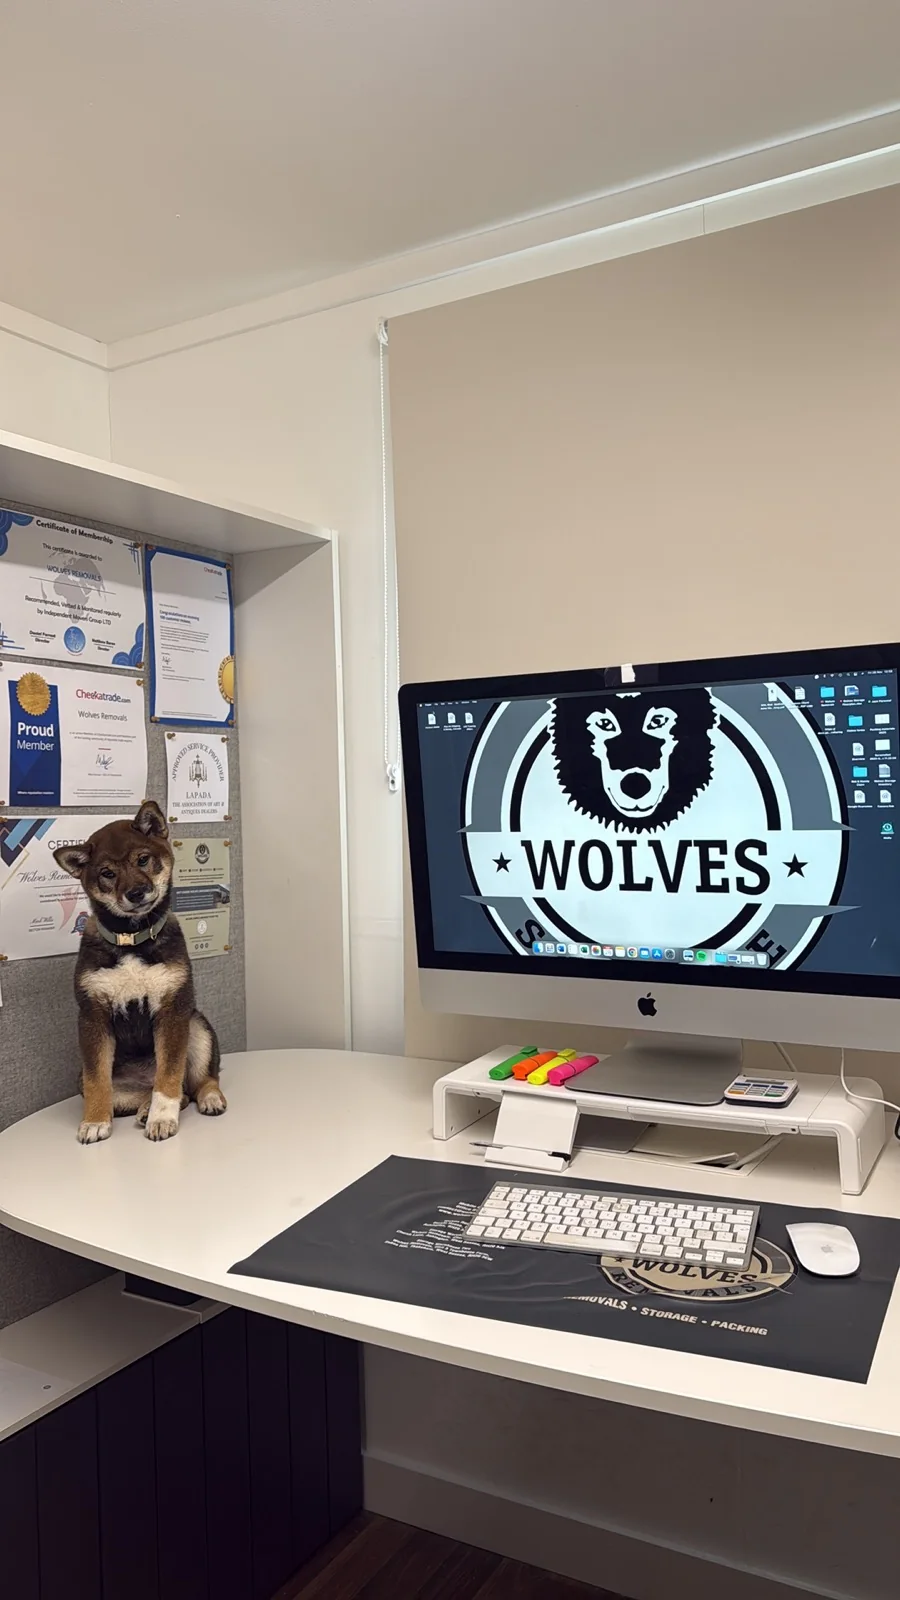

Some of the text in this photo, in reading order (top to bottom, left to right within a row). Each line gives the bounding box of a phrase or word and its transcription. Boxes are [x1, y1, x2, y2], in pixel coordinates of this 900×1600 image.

[36, 520, 69, 534] Certificate
[78, 529, 114, 544] Membership
[47, 565, 102, 581] WOLVES REMOVALS
[44, 609, 72, 619] Independent
[78, 711, 128, 721] Wolves Removals
[17, 722, 54, 737] Proud
[17, 740, 54, 751] Member
[172, 742, 225, 782] APPROVED SERVICE PROVIDER
[521, 839, 771, 896] WOLVES
[640, 1307, 698, 1324] STORAGE
[710, 1319, 768, 1336] PACKING
